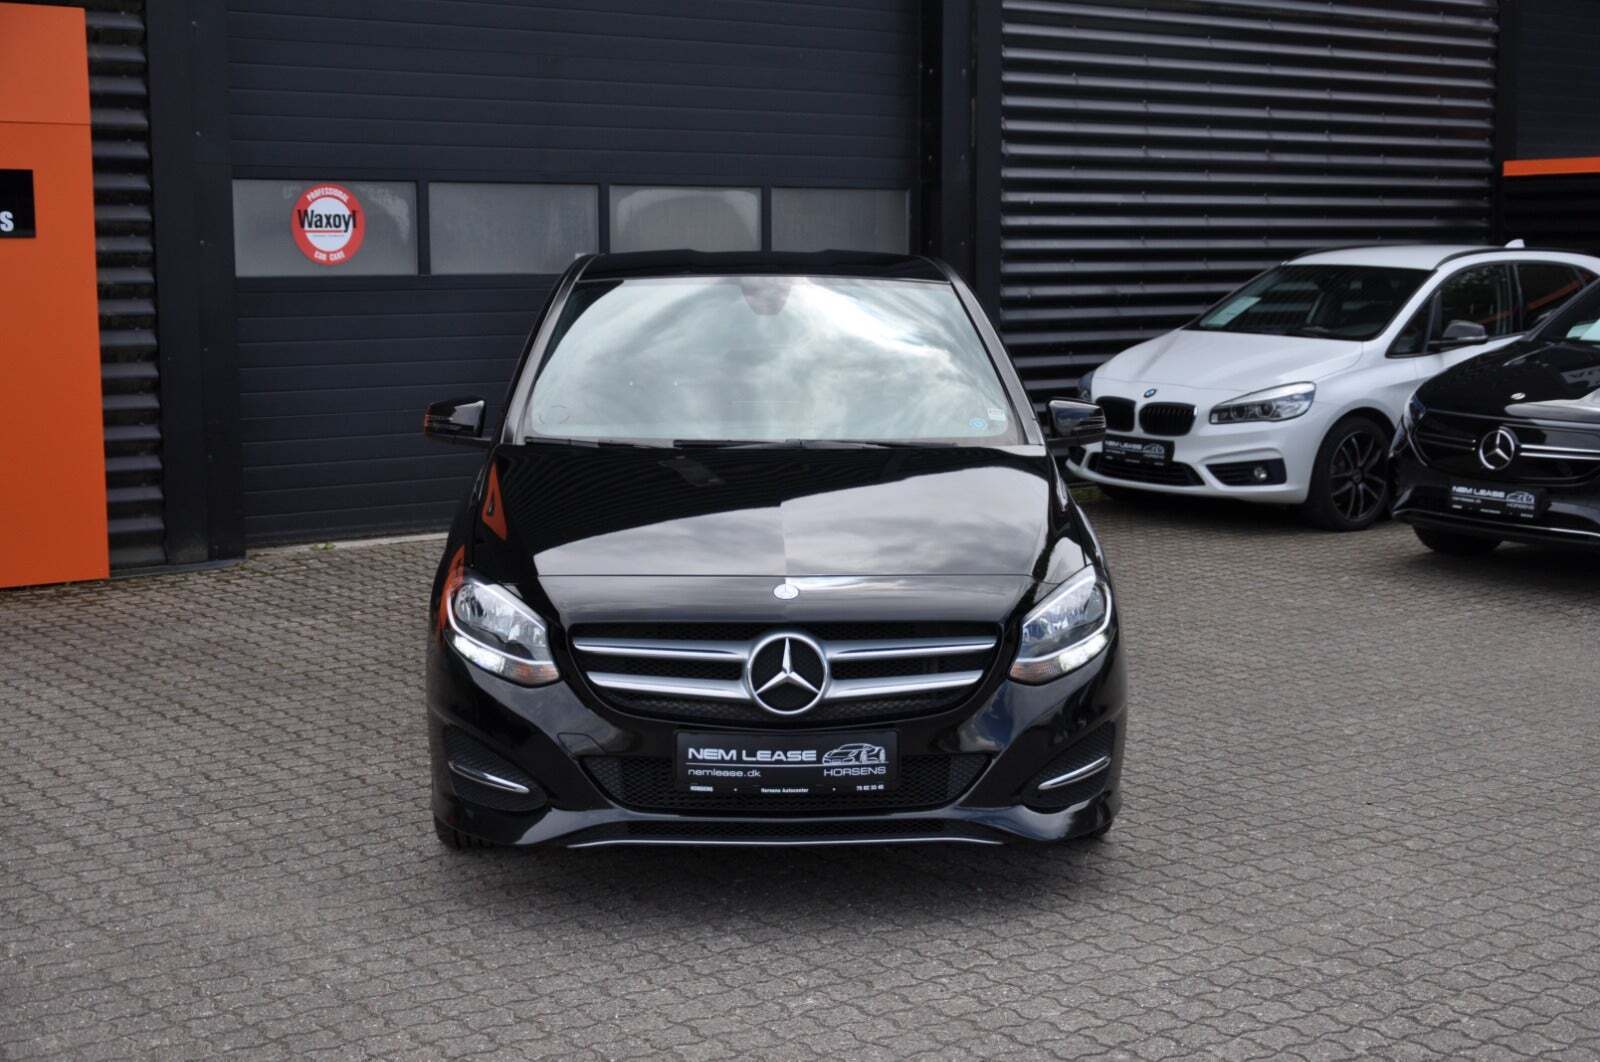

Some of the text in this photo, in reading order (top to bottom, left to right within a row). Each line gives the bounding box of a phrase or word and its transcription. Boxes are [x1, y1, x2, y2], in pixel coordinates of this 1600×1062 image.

[306, 187, 349, 202] PROFESSIONAL
[297, 209, 357, 233] Waxoyl
[688, 747, 817, 761] NEM LEASE
[688, 768, 761, 777] nemlease.dk
[823, 766, 887, 777] HORSENS
